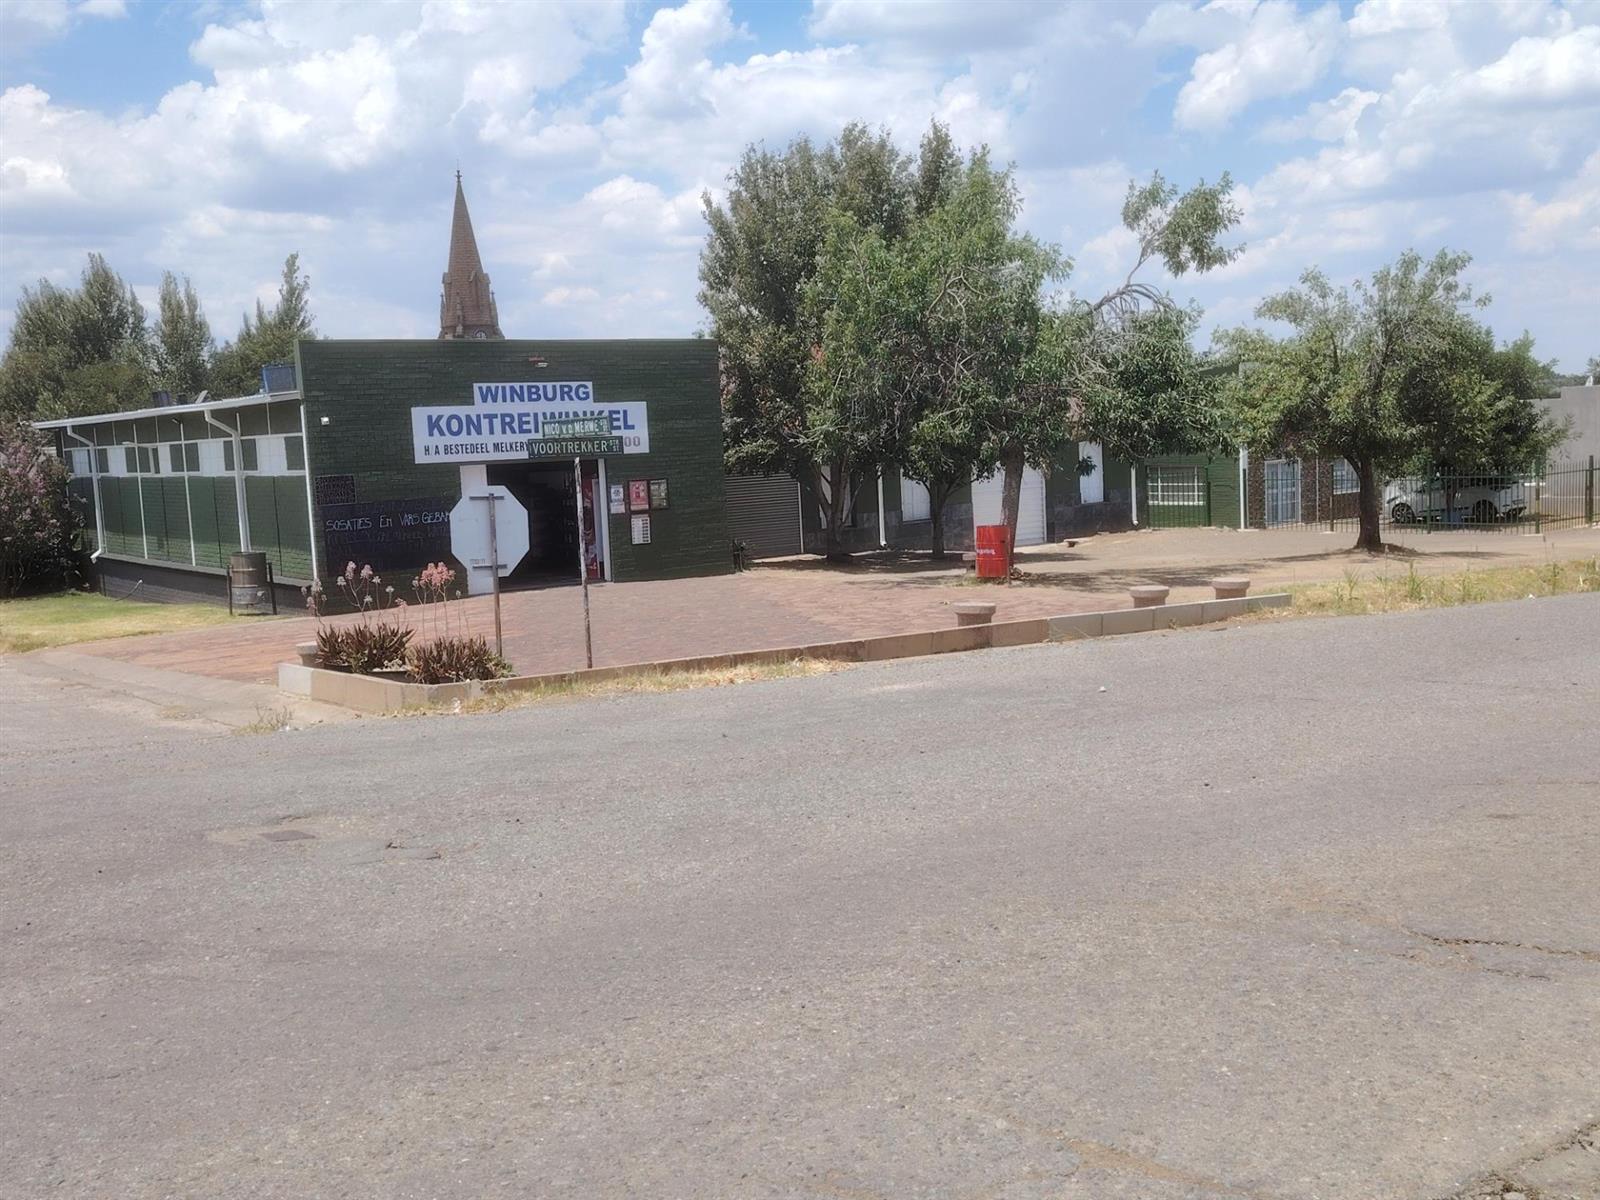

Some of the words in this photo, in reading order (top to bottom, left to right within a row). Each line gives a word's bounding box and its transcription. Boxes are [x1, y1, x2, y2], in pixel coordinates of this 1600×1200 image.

[478, 384, 590, 403] WINBURG
[543, 423, 559, 434] NICO
[574, 419, 599, 433] MERWE
[443, 442, 489, 455] BESTEDEEL
[532, 440, 608, 455] VOORTREKKER
